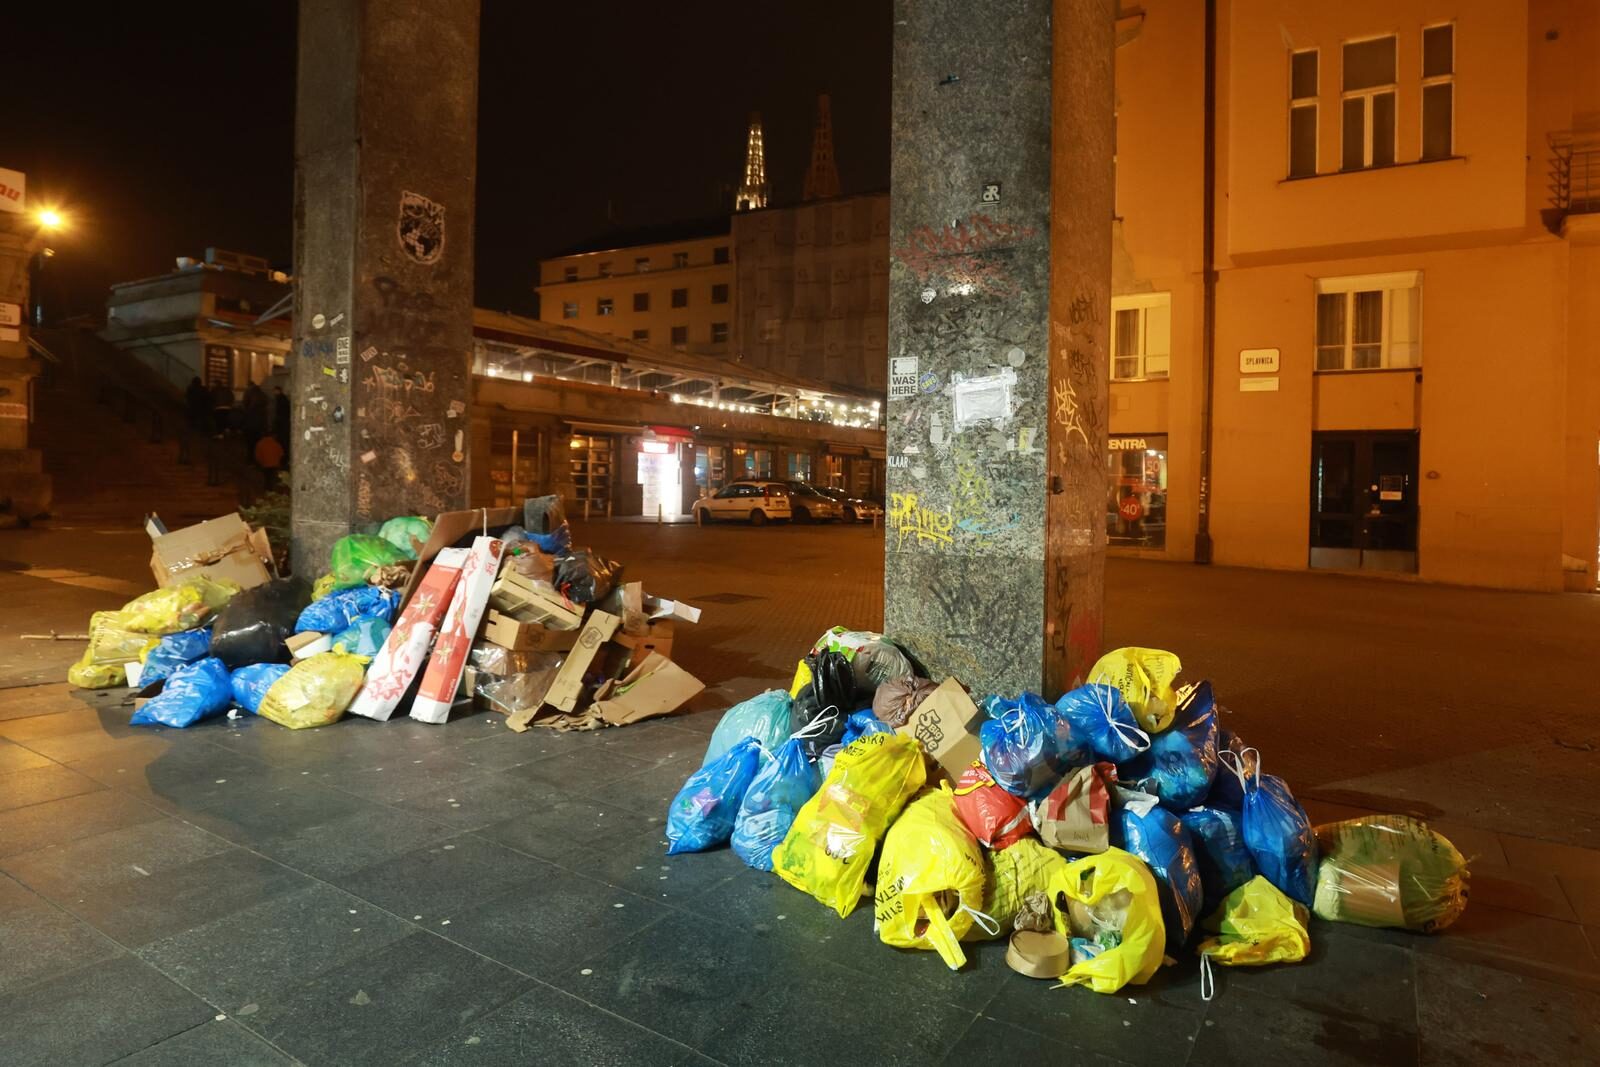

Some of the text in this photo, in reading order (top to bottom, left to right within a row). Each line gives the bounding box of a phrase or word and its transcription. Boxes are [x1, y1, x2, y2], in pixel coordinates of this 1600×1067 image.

[1245, 356, 1273, 366] SPLAVNICA
[892, 376, 916, 385] WAS
[892, 386, 916, 395] HERE
[1108, 439, 1147, 450] ENTRA
[919, 709, 941, 727] 5
